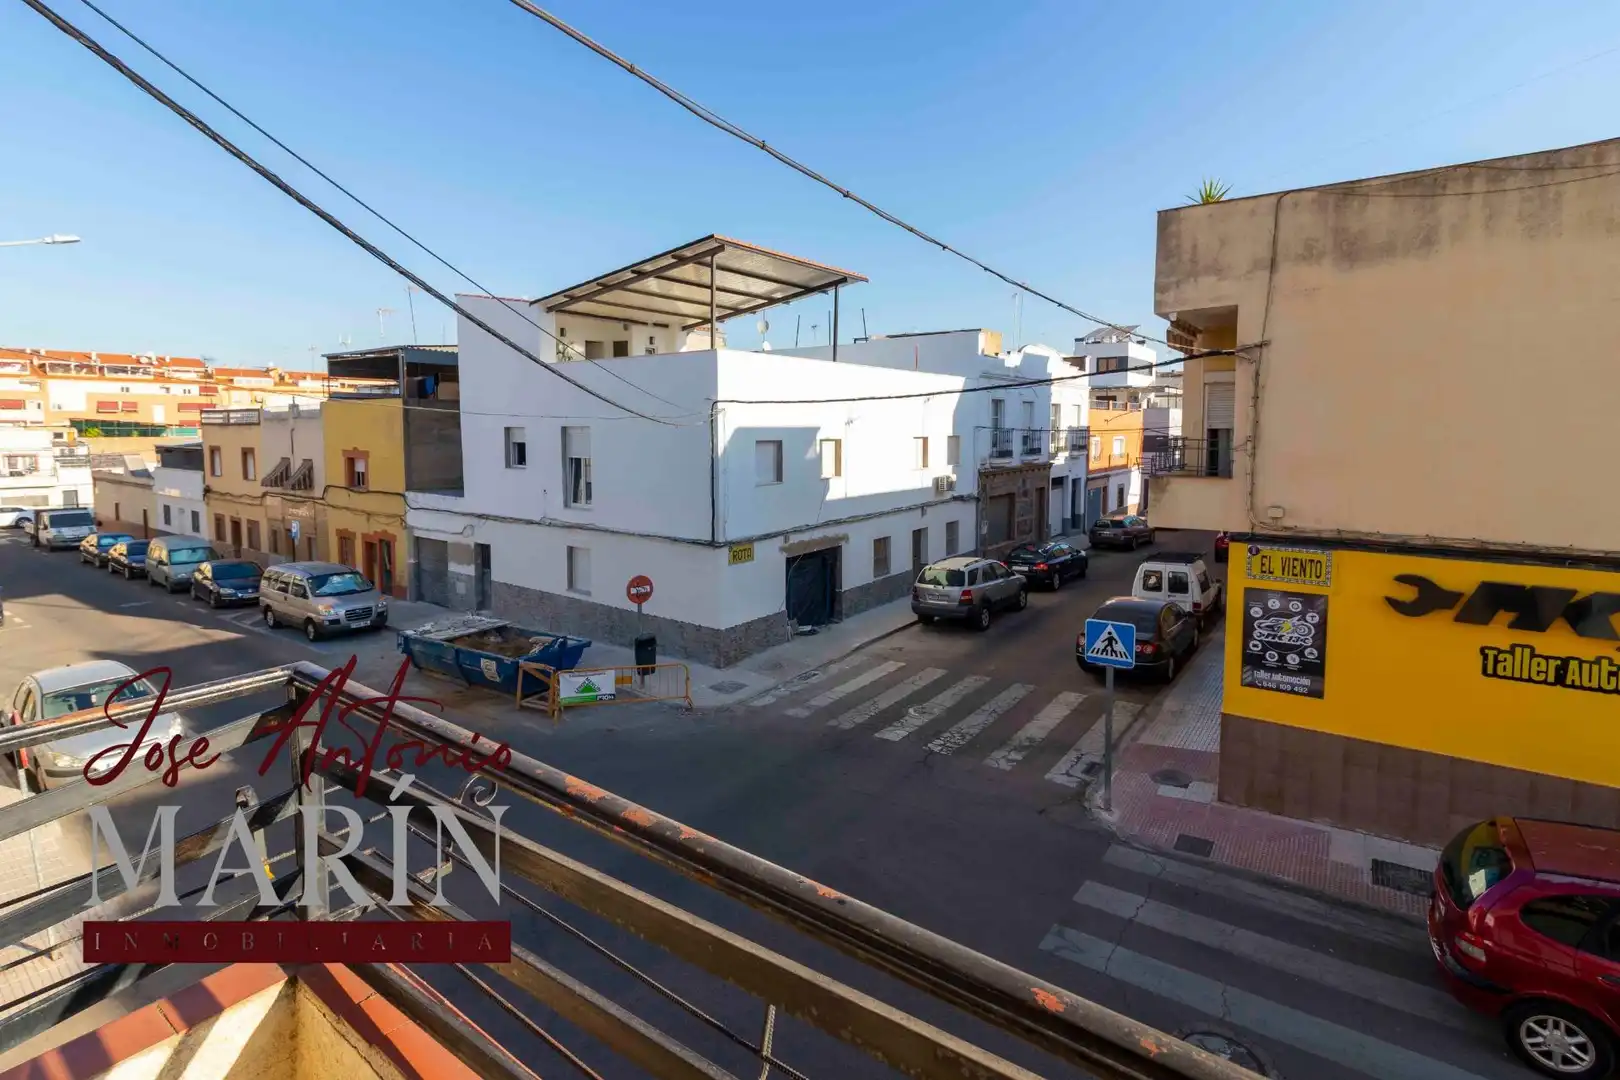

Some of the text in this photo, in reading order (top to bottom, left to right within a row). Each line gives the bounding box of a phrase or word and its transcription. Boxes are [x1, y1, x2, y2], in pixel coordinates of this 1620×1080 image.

[733, 548, 752, 562] ROTA
[1261, 555, 1322, 579] EL VIENTO
[1484, 646, 1620, 691] Taller Aut
[1254, 669, 1311, 686] Taller Automoción
[1280, 683, 1292, 691] 109
